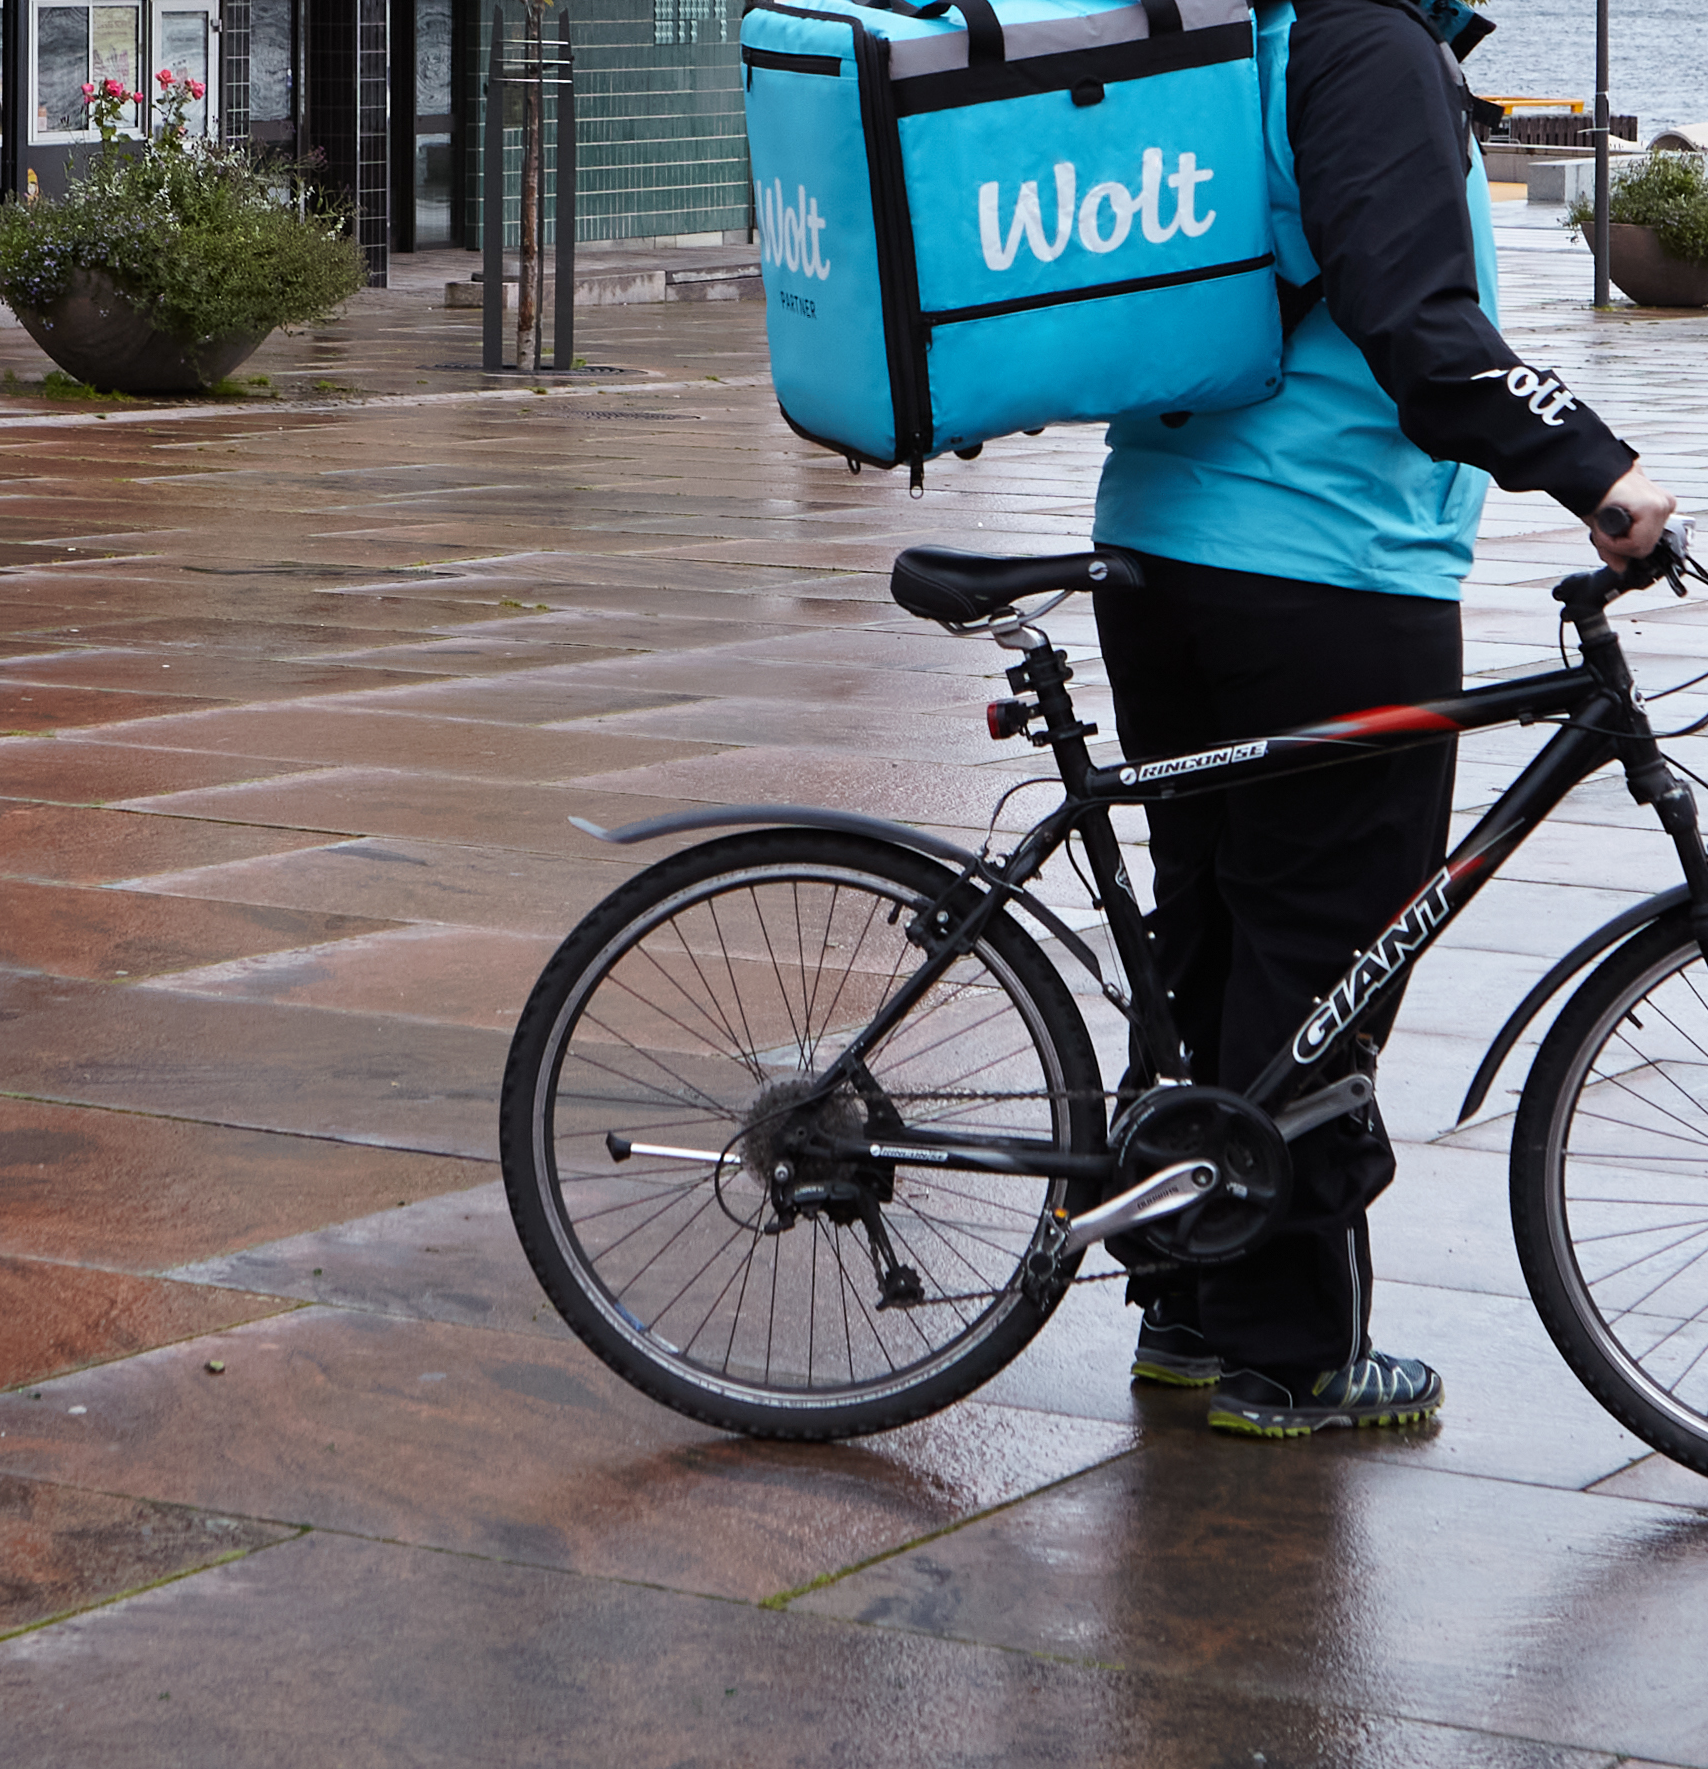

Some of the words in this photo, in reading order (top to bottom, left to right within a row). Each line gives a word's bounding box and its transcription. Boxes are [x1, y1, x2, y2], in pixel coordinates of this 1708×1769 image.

[755, 177, 831, 281] Wolt
[978, 147, 1217, 271] Wolt
[780, 290, 817, 320] PARTNER
[1470, 366, 1577, 426] olt
[1140, 749, 1229, 780] RINCON
[1233, 742, 1267, 761] SE
[1293, 865, 1452, 1064] GIANT
